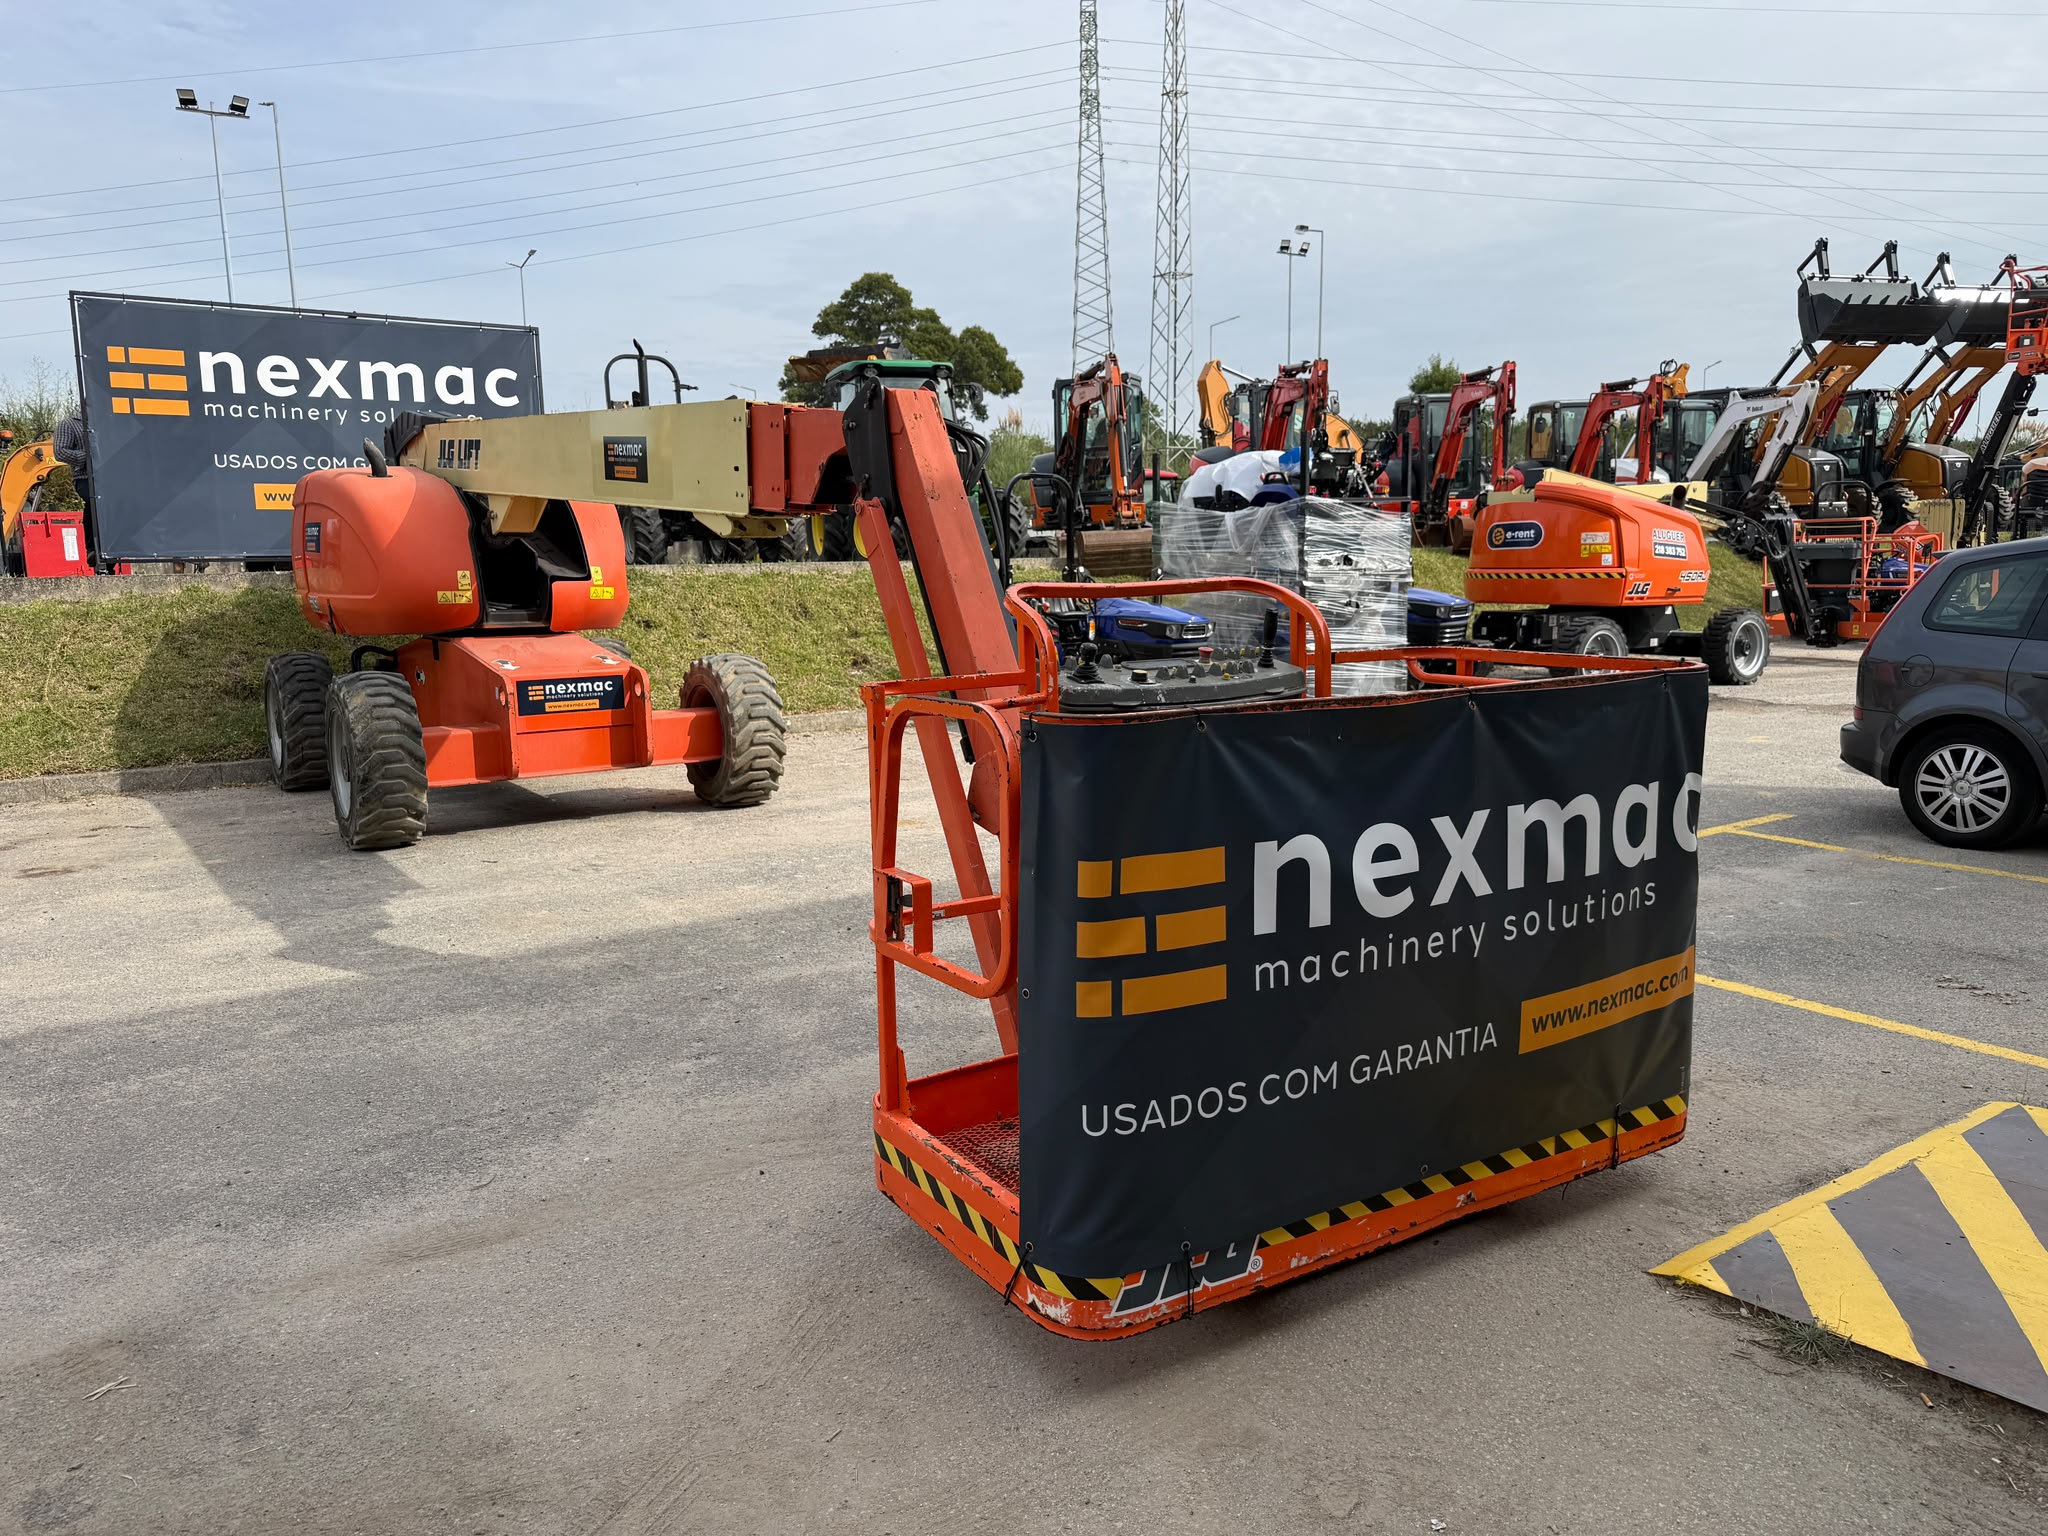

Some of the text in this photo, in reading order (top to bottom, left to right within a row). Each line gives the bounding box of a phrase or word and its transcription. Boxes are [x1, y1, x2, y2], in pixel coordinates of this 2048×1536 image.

[199, 351, 520, 408] nexmac
[204, 402, 348, 425] machinery
[437, 439, 481, 470] JLG LIFT
[614, 443, 643, 456] nexmac
[214, 454, 298, 470] USADOS
[303, 456, 347, 470] COM
[1505, 528, 1535, 539] e-rent
[1652, 529, 1685, 542] ALUGUER
[1626, 581, 1652, 596] JLG
[545, 680, 614, 695] nexmac
[1254, 772, 1702, 936] nexmac
[1255, 882, 1656, 991] machinery solutions
[1531, 964, 1689, 1034] www.nexmac.com
[1081, 1022, 1498, 1137] USADOS COM GARANTIA
